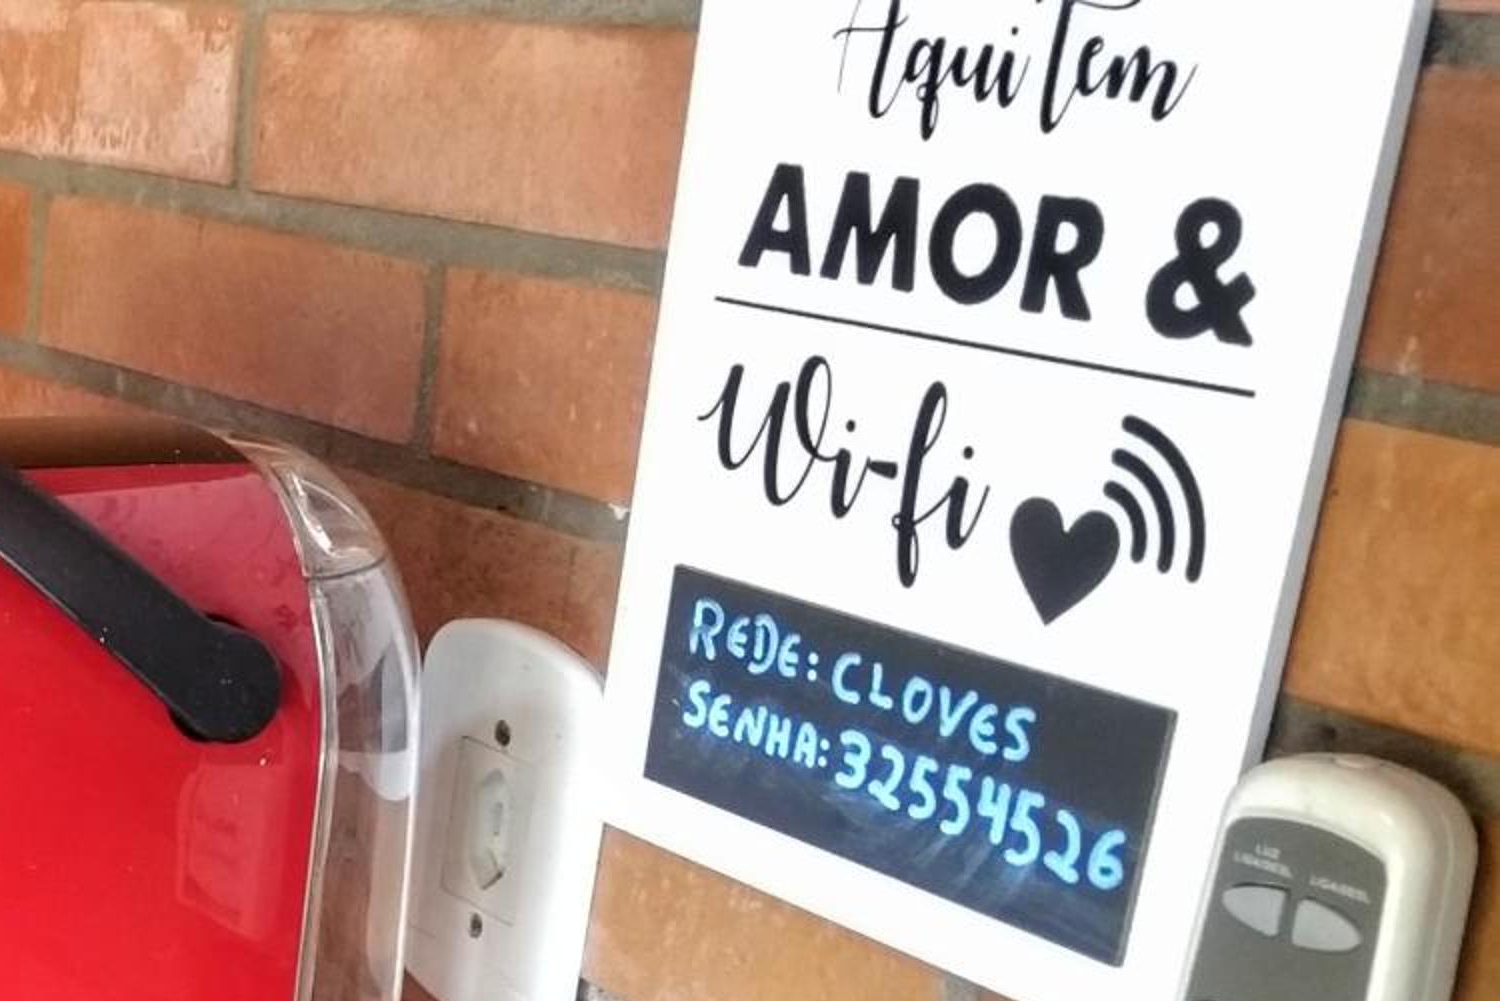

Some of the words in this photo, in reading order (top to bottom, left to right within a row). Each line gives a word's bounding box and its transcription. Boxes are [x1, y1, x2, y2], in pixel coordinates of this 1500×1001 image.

[833, 0, 1030, 140] Aqui
[1035, 0, 1199, 134] Tem
[738, 163, 1104, 321] AMOR
[1145, 197, 1256, 347] &
[698, 355, 991, 588] Wi-fi
[687, 598, 819, 681] REDE:
[831, 652, 1038, 763] CLOVES
[682, 680, 830, 768] SENHA:
[834, 730, 1128, 890] 32554526
